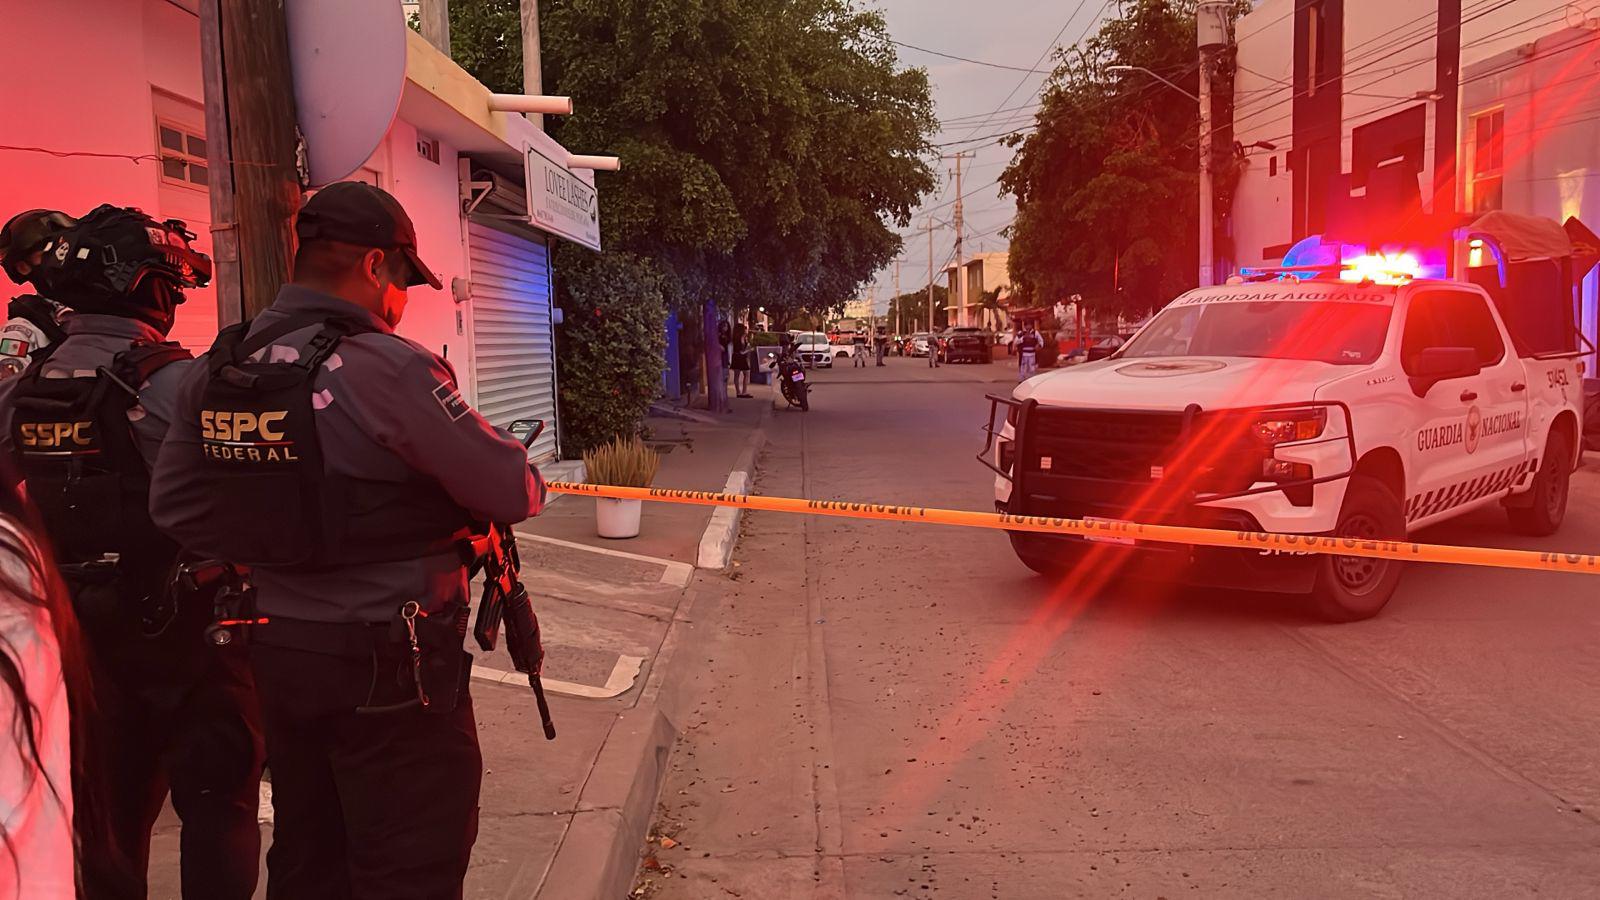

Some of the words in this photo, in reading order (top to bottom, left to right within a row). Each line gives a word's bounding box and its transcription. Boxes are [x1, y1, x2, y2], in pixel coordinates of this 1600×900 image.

[567, 179, 589, 213] LASHES
[21, 421, 93, 447] SSPC
[201, 410, 289, 441] SSPC
[1417, 422, 1463, 452] GUARDIA
[1480, 410, 1521, 438] NACIONAL
[203, 443, 298, 461] FEDERAL
